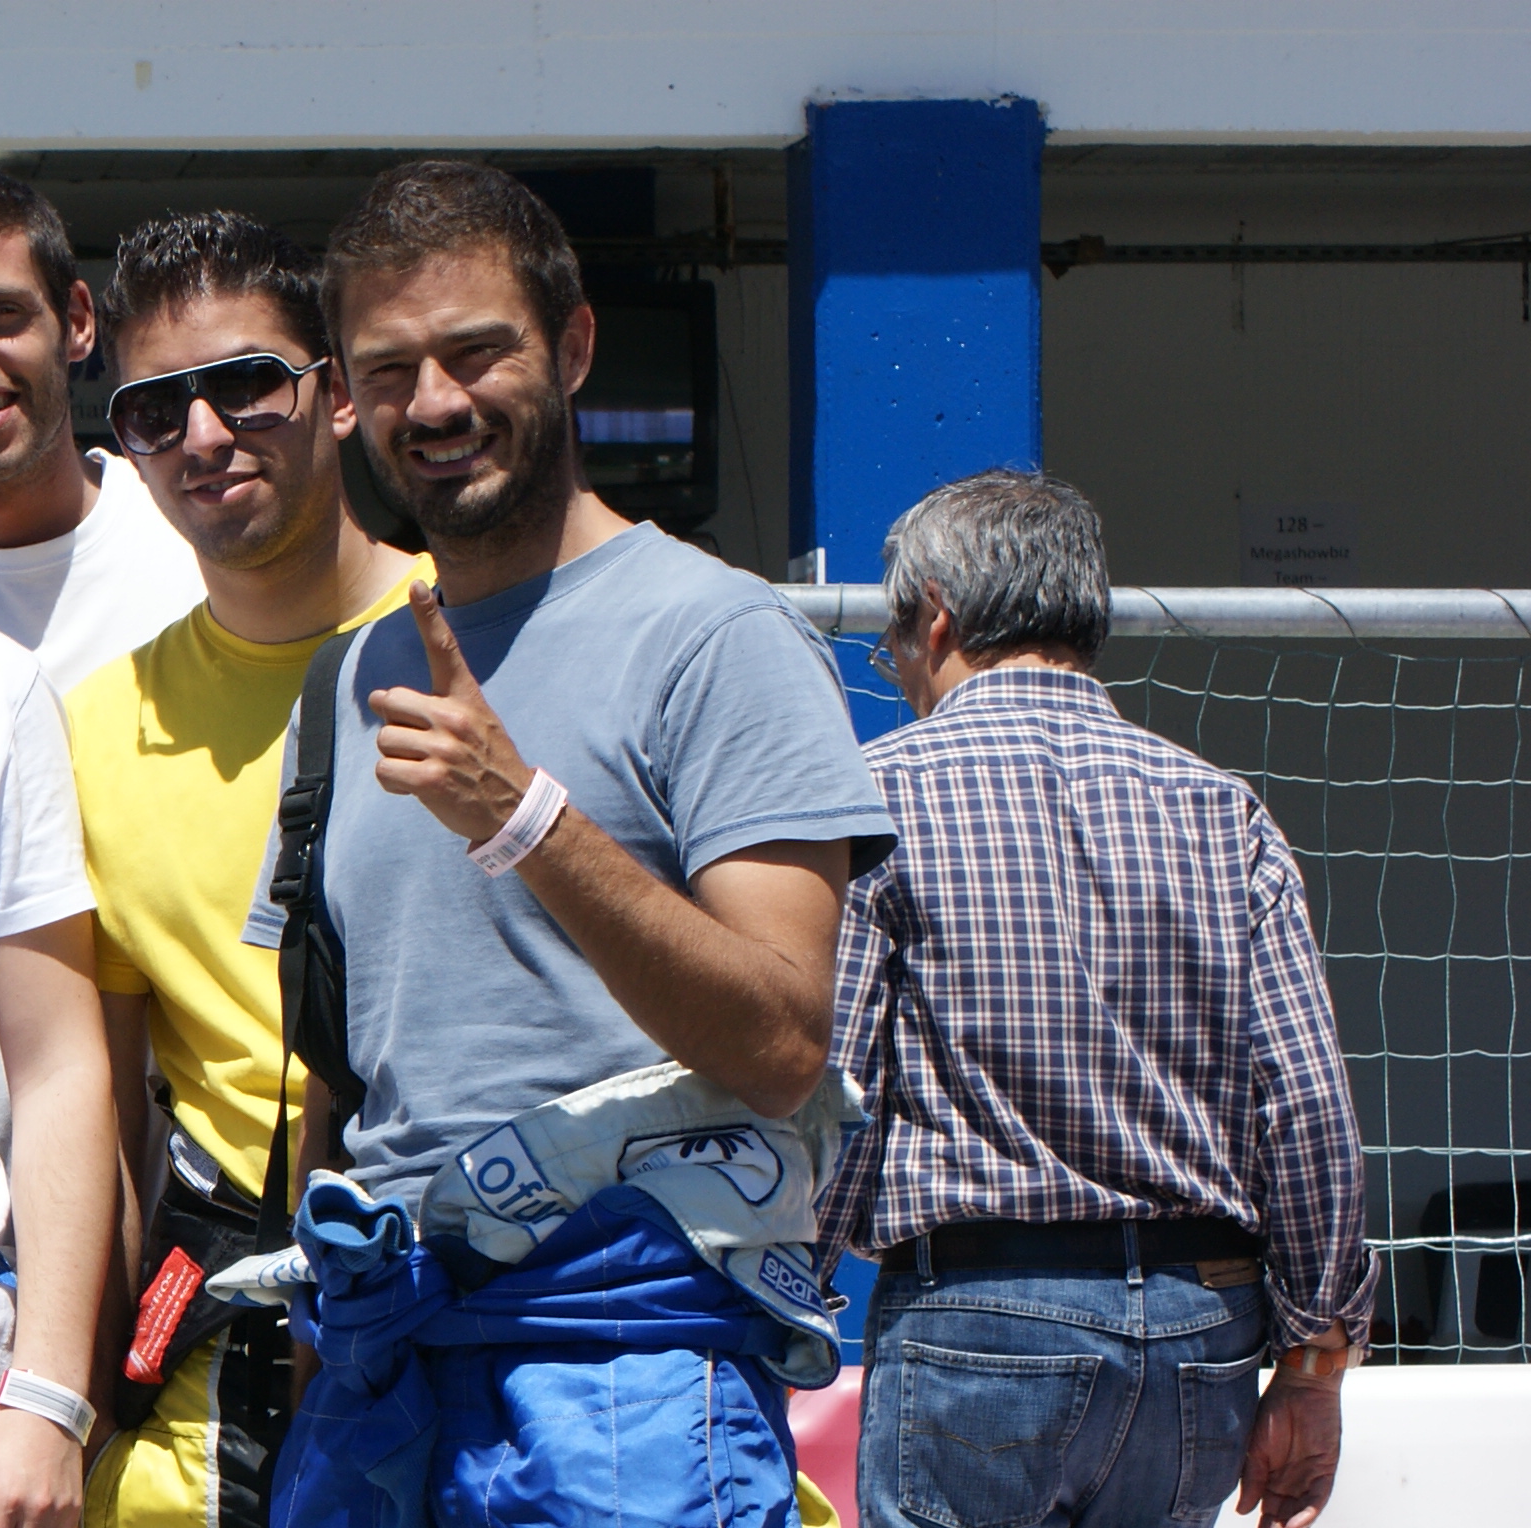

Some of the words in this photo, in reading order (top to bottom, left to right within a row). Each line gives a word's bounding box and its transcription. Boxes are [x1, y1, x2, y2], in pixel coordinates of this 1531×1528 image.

[1277, 516, 1307, 533] 128
[1250, 546, 1349, 562] Megashowbiz
[1275, 571, 1313, 584] Team
